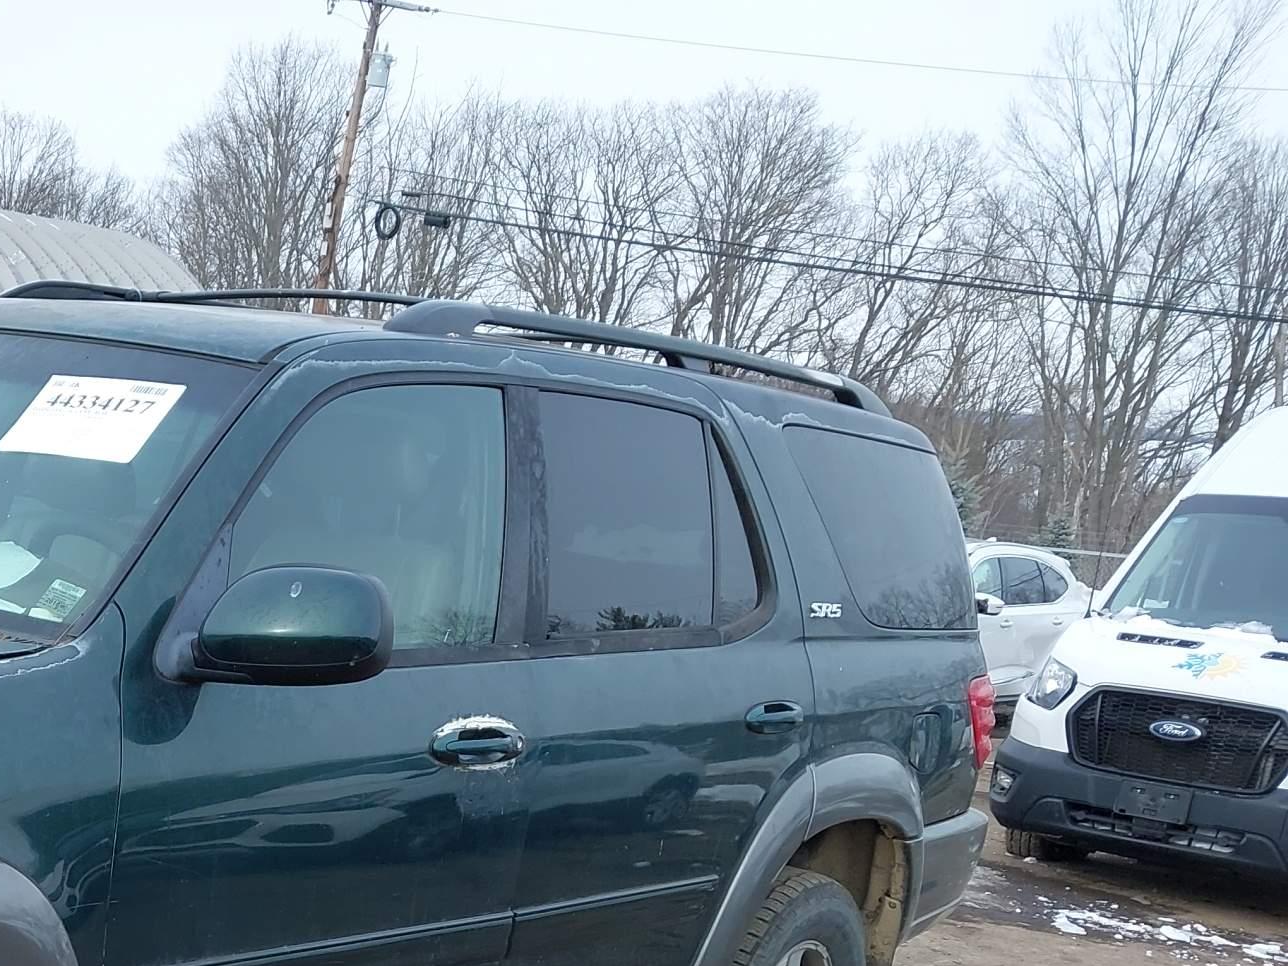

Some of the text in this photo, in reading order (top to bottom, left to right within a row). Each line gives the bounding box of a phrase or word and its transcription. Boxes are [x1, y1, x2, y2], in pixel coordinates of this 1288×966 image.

[46, 393, 156, 415] 44334127
[810, 602, 842, 618] SR5
[1159, 723, 1189, 737] Ford
